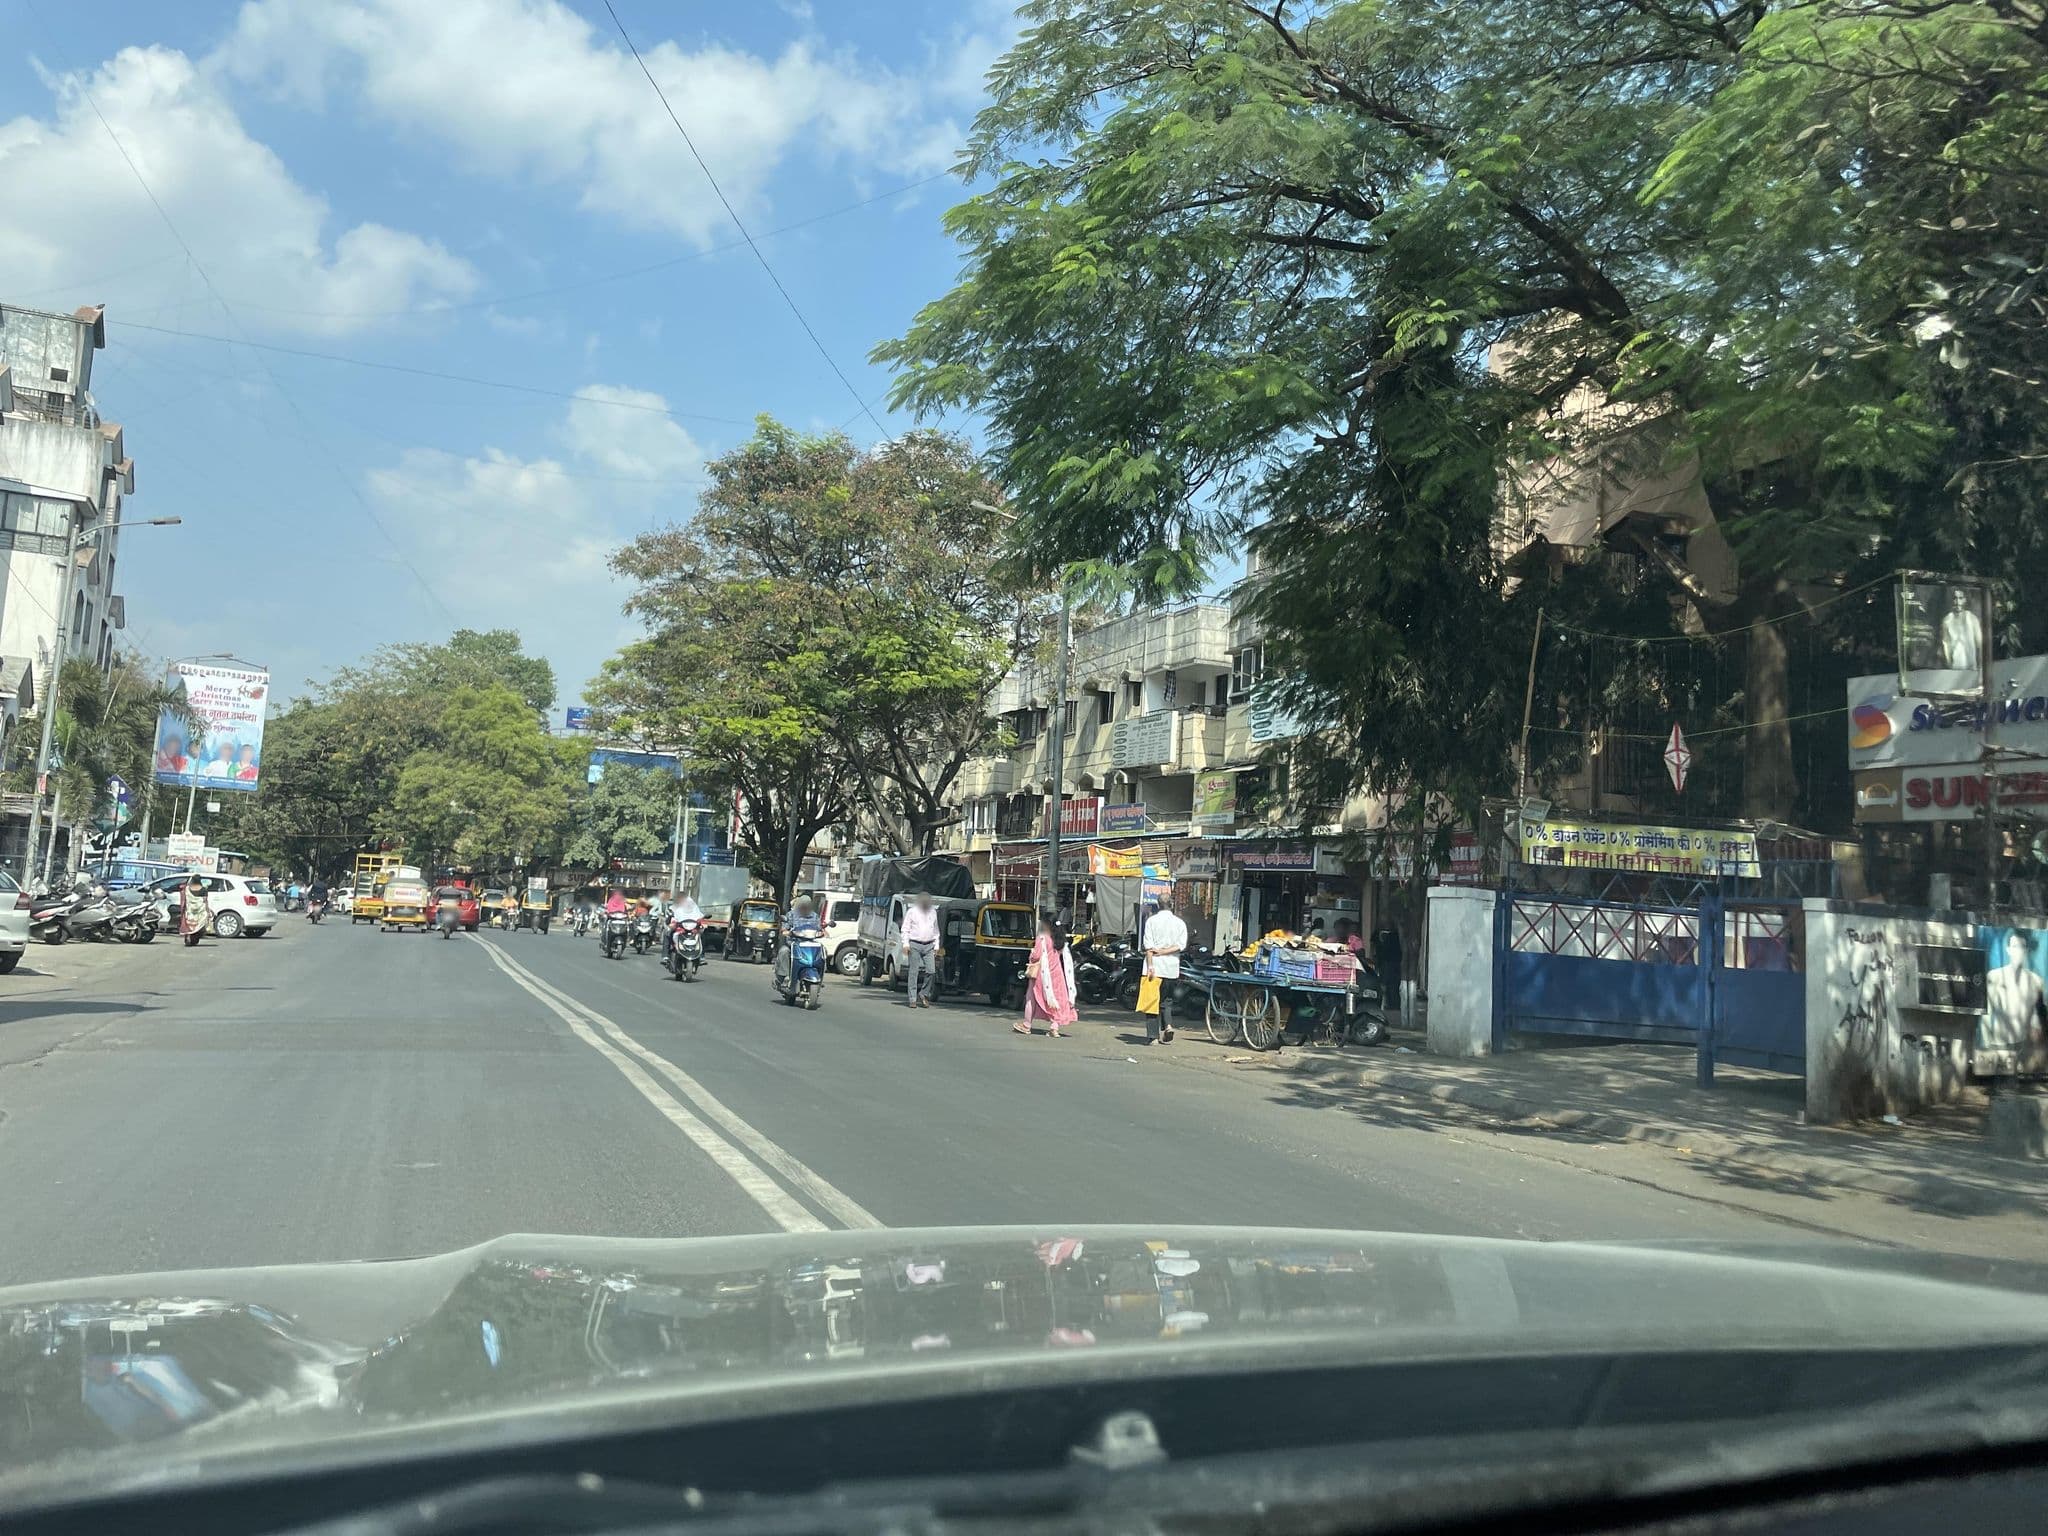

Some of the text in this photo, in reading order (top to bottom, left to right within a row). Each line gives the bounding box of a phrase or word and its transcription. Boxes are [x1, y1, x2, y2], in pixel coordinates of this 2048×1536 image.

[205, 685, 233, 695] Merry
[194, 691, 242, 702] Christmas
[1905, 775, 1989, 809] SUN
